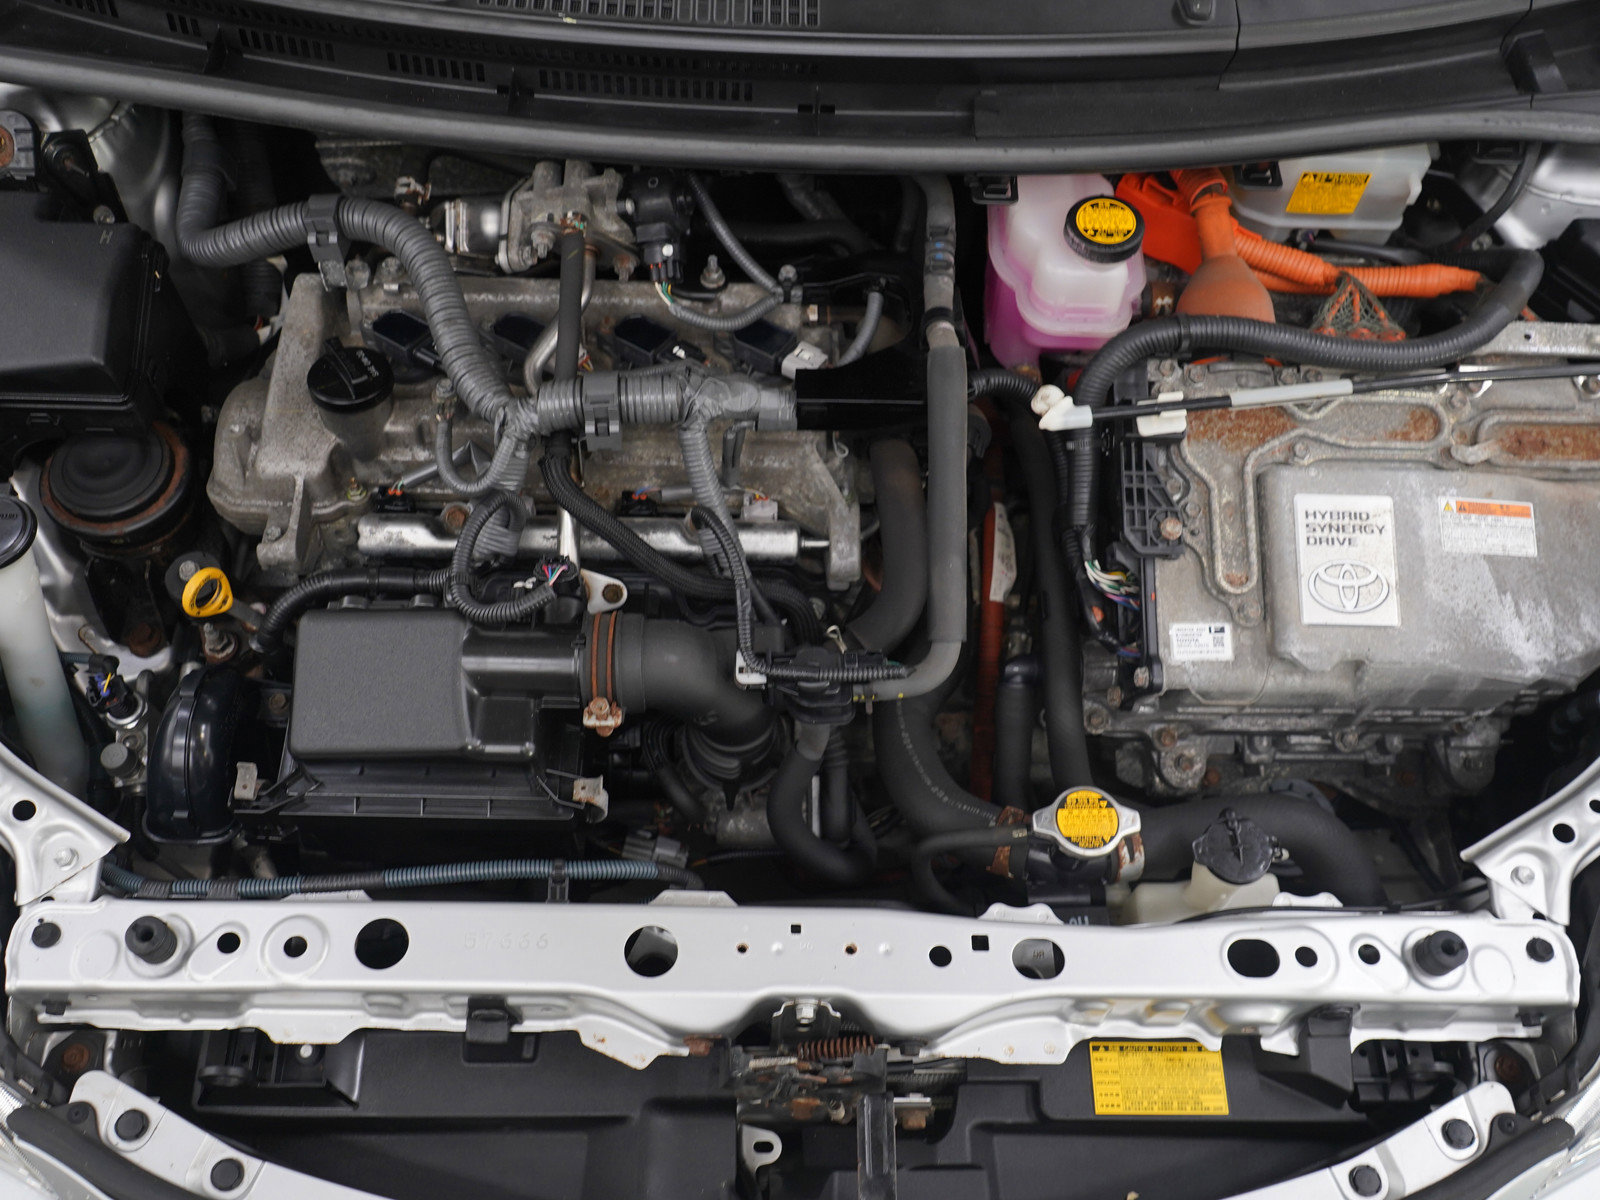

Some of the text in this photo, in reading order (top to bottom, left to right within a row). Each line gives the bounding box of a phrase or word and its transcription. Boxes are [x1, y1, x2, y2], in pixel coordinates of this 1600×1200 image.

[1305, 510, 1370, 520] HYBRID
[1305, 523, 1385, 534] SYNERGY
[1306, 536, 1358, 546] DRIVE
